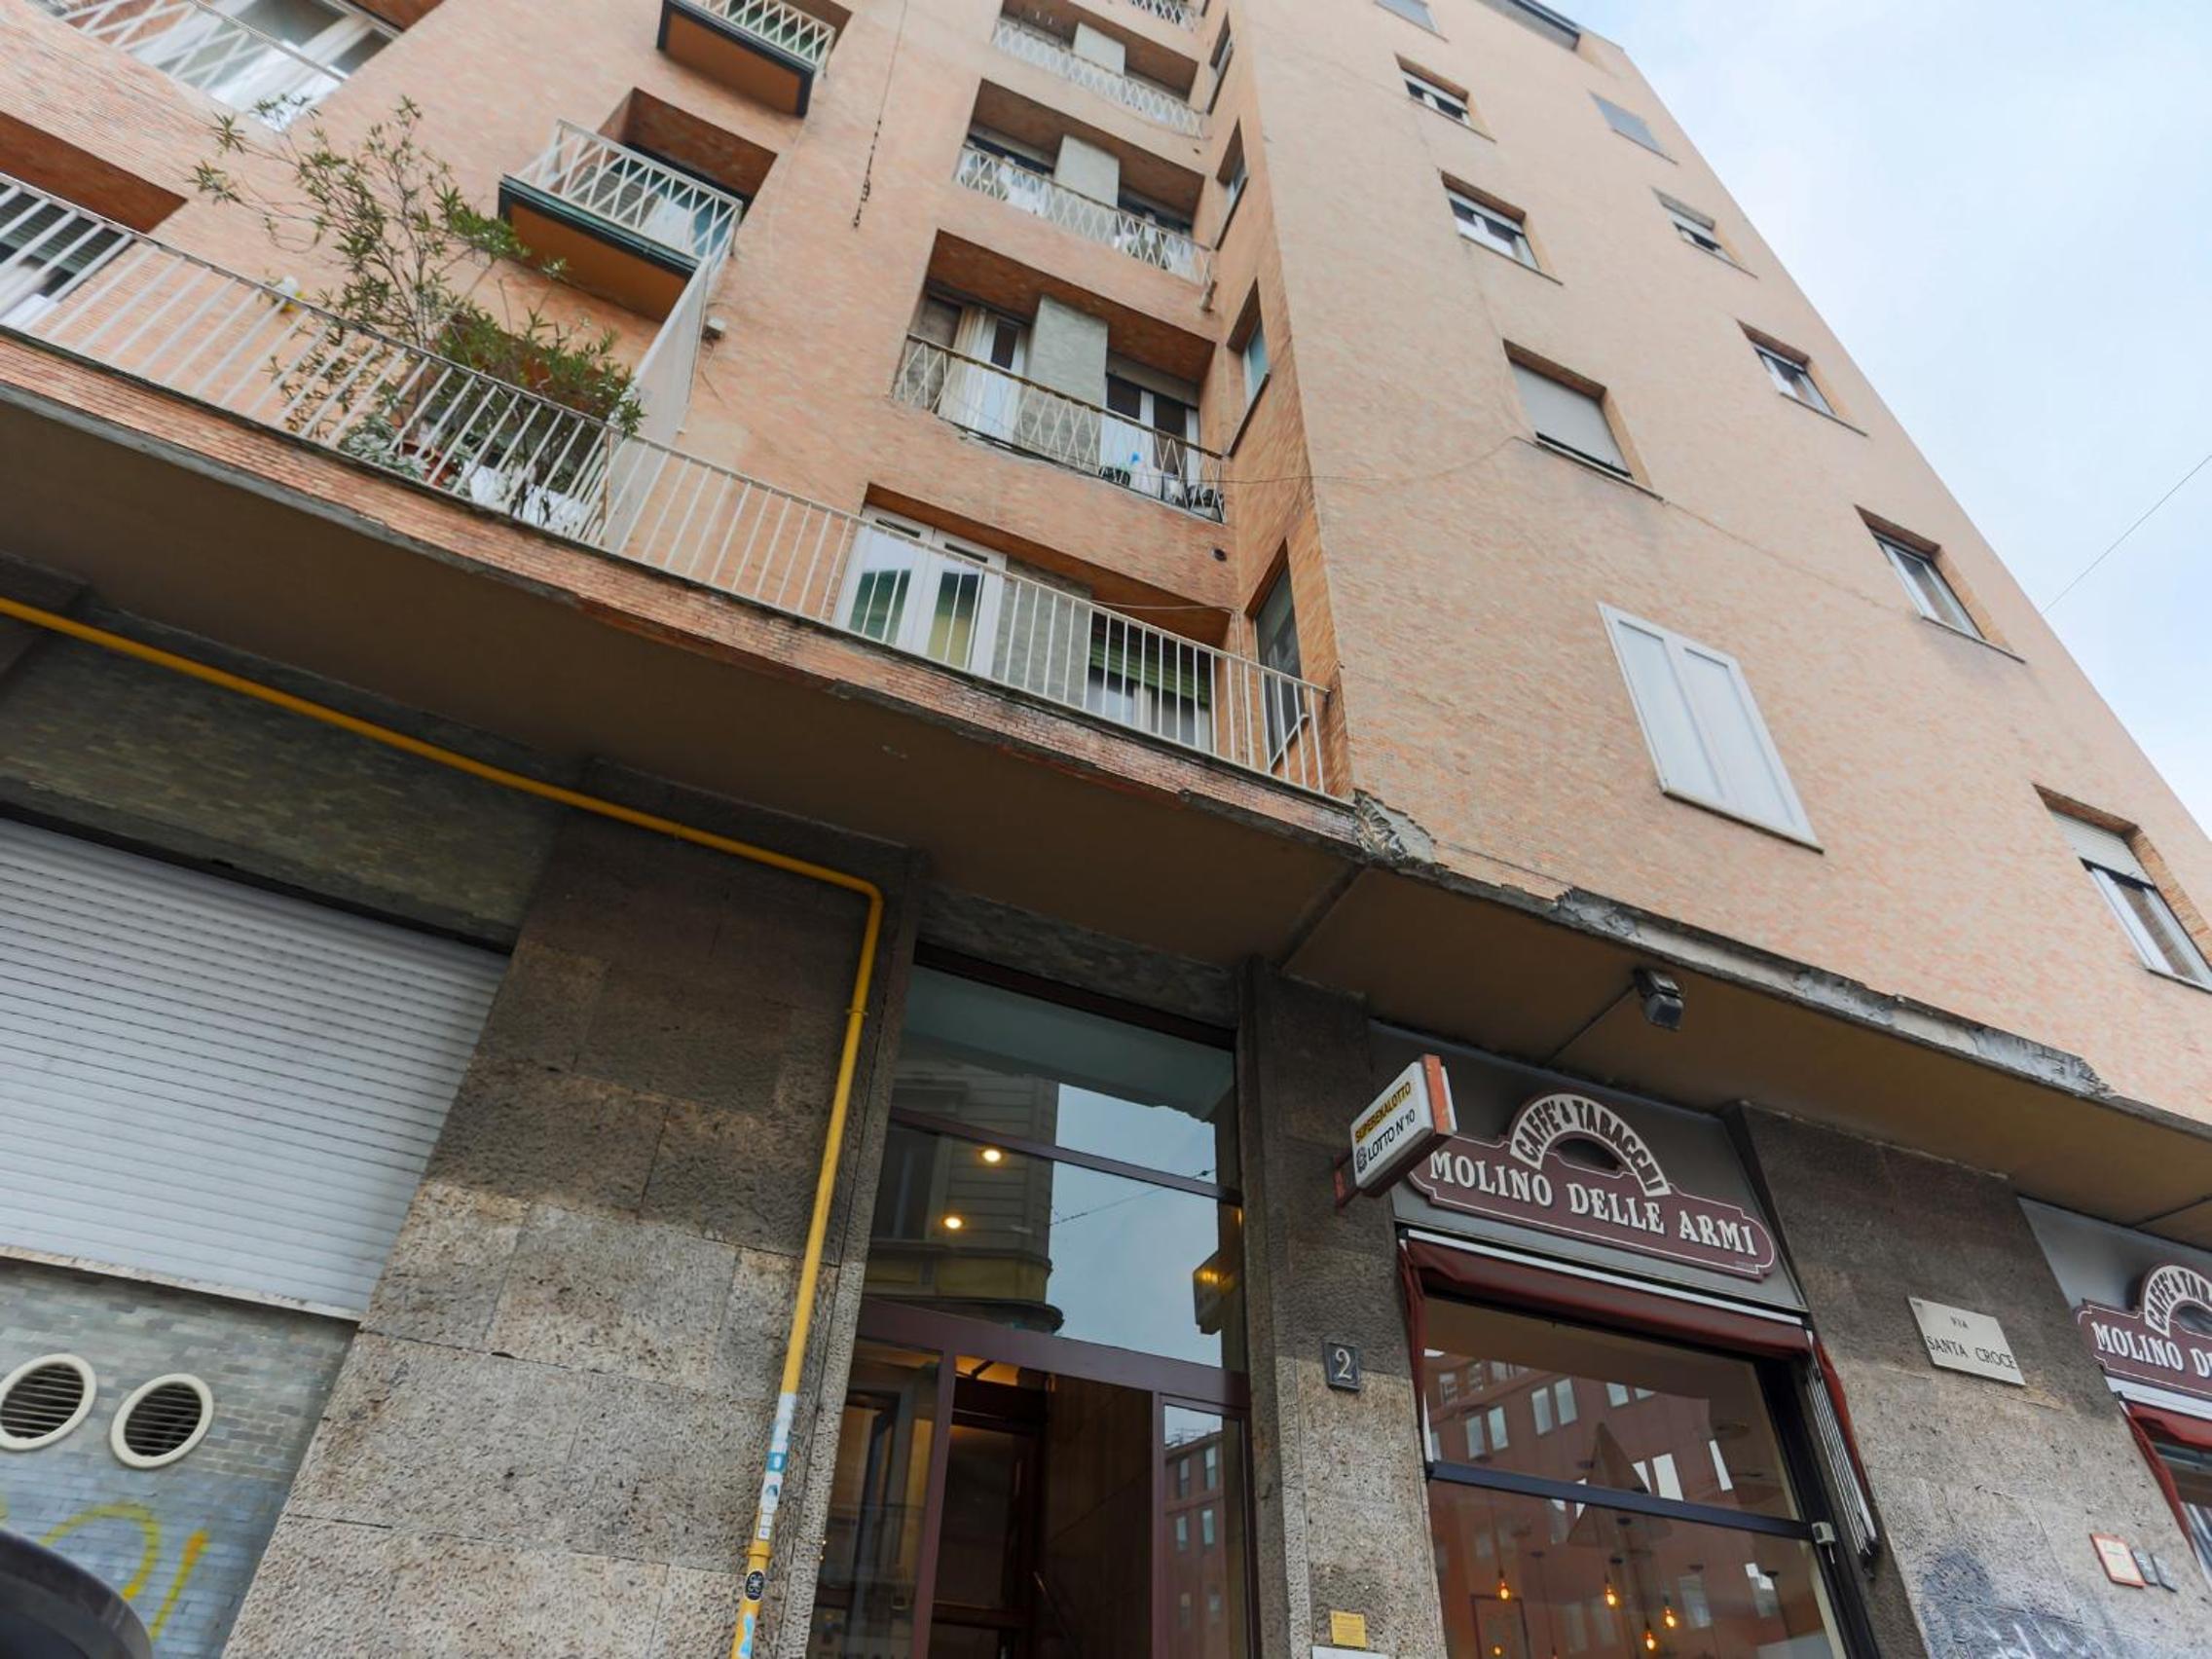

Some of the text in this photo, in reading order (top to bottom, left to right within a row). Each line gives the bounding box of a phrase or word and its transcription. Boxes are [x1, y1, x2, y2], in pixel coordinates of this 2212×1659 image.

[1368, 1126, 1396, 1161] LOTTO
[1429, 1150, 1758, 1256] MOLINO DELLE ARMI
[1950, 1315, 1969, 1330] VIA
[1335, 1347, 1352, 1380] 2
[1926, 1335, 2018, 1370] SANTA CROCE
[2090, 1321, 2184, 1371] MOLINO
